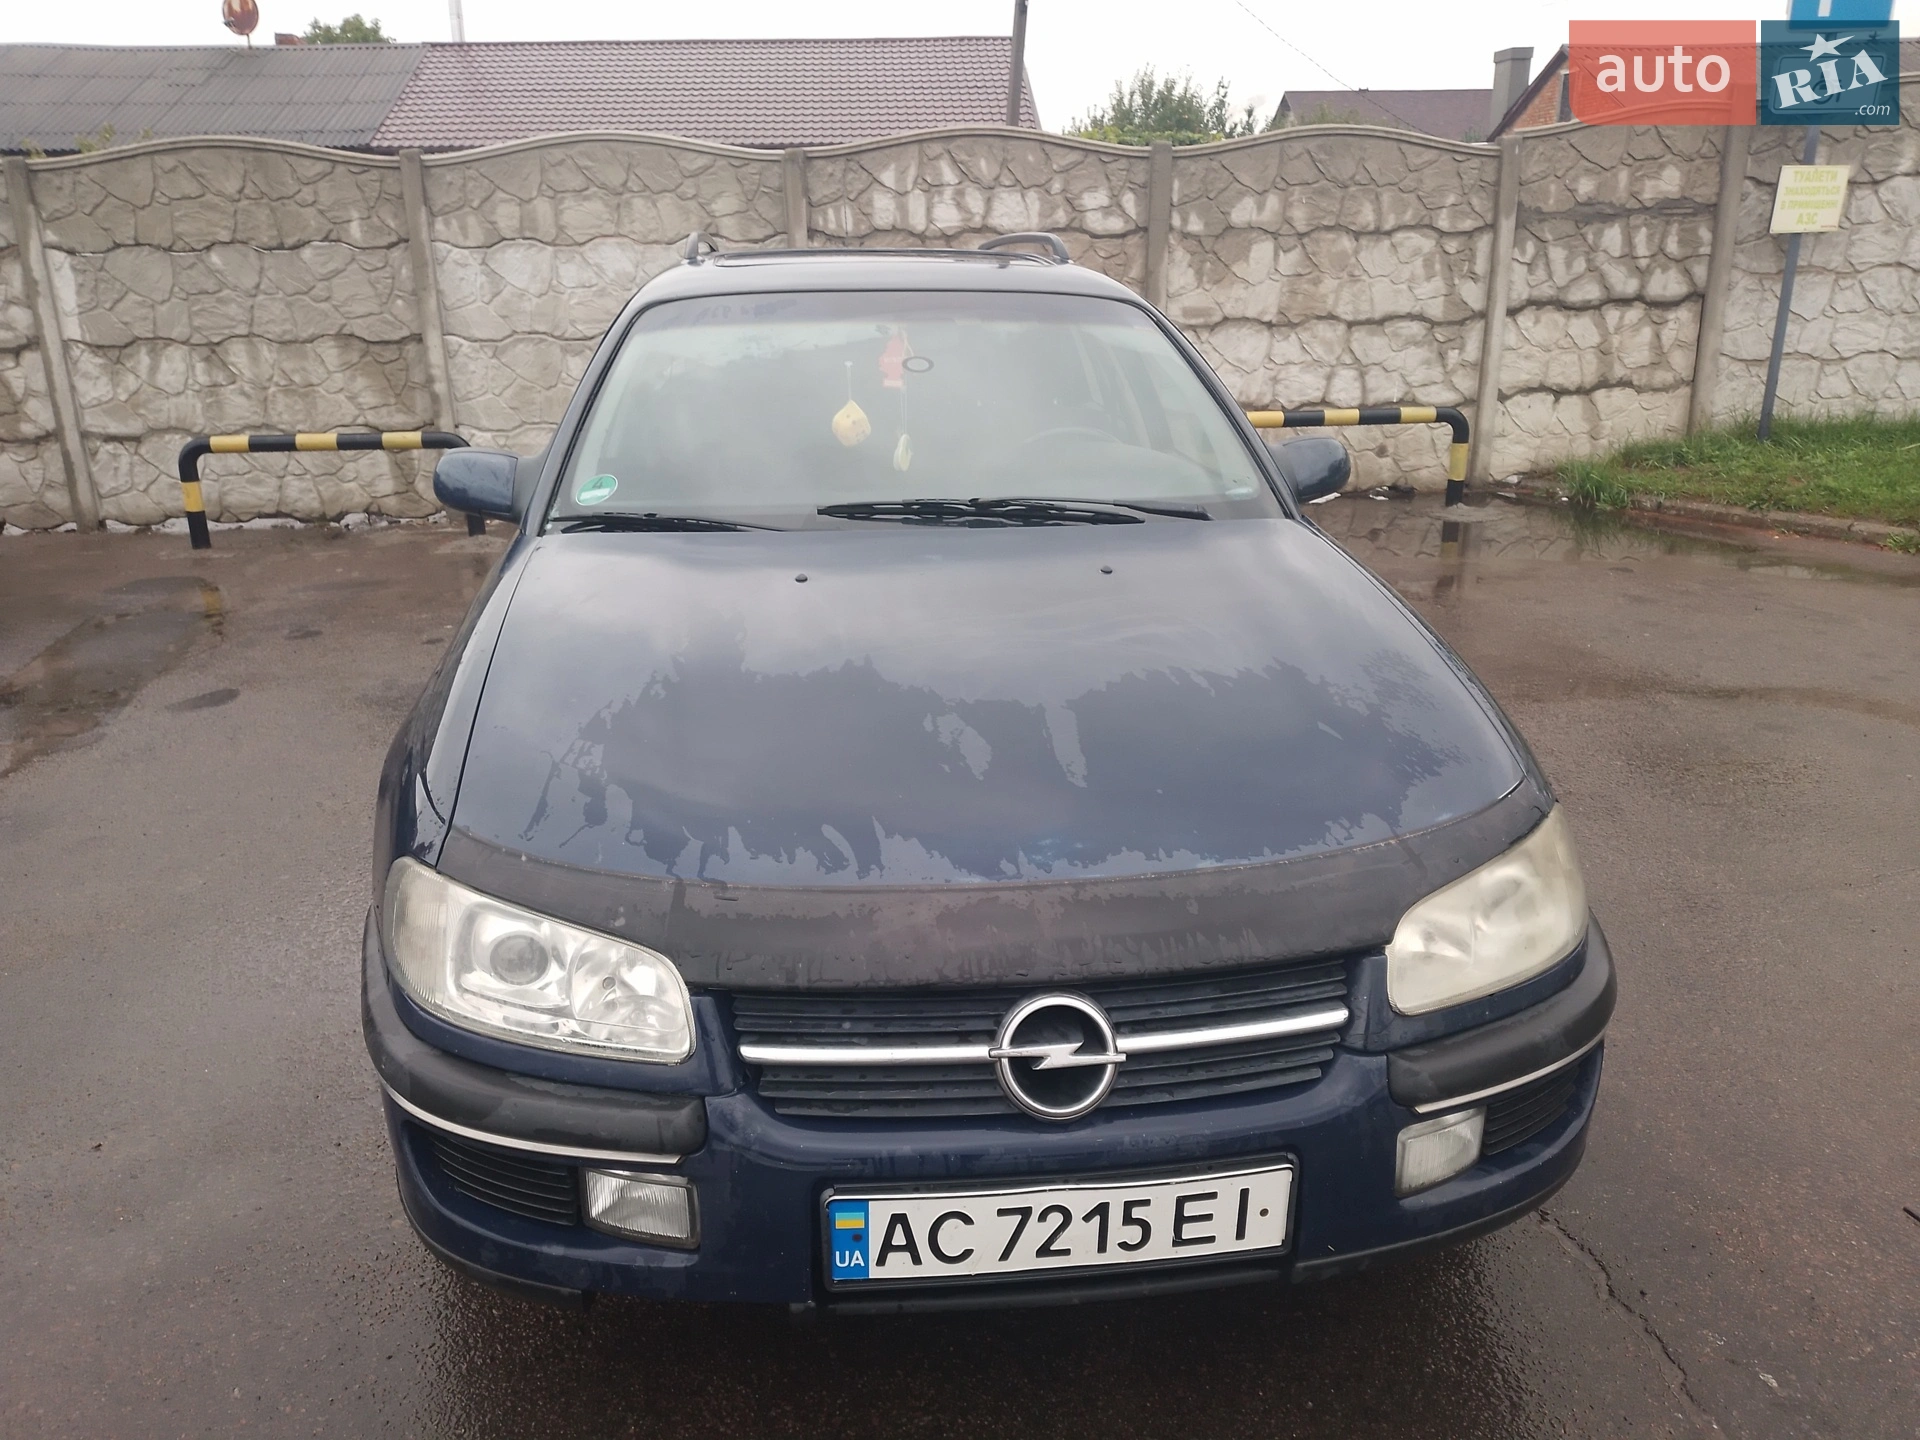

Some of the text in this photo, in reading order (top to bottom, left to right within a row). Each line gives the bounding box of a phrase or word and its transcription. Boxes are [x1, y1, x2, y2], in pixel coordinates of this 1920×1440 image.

[1793, 170, 1838, 183] ТУАЛЕТИ
[1796, 212, 1818, 225] АЗС
[875, 1187, 1251, 1267] AC 7215 EI
[835, 1250, 865, 1268] UA
